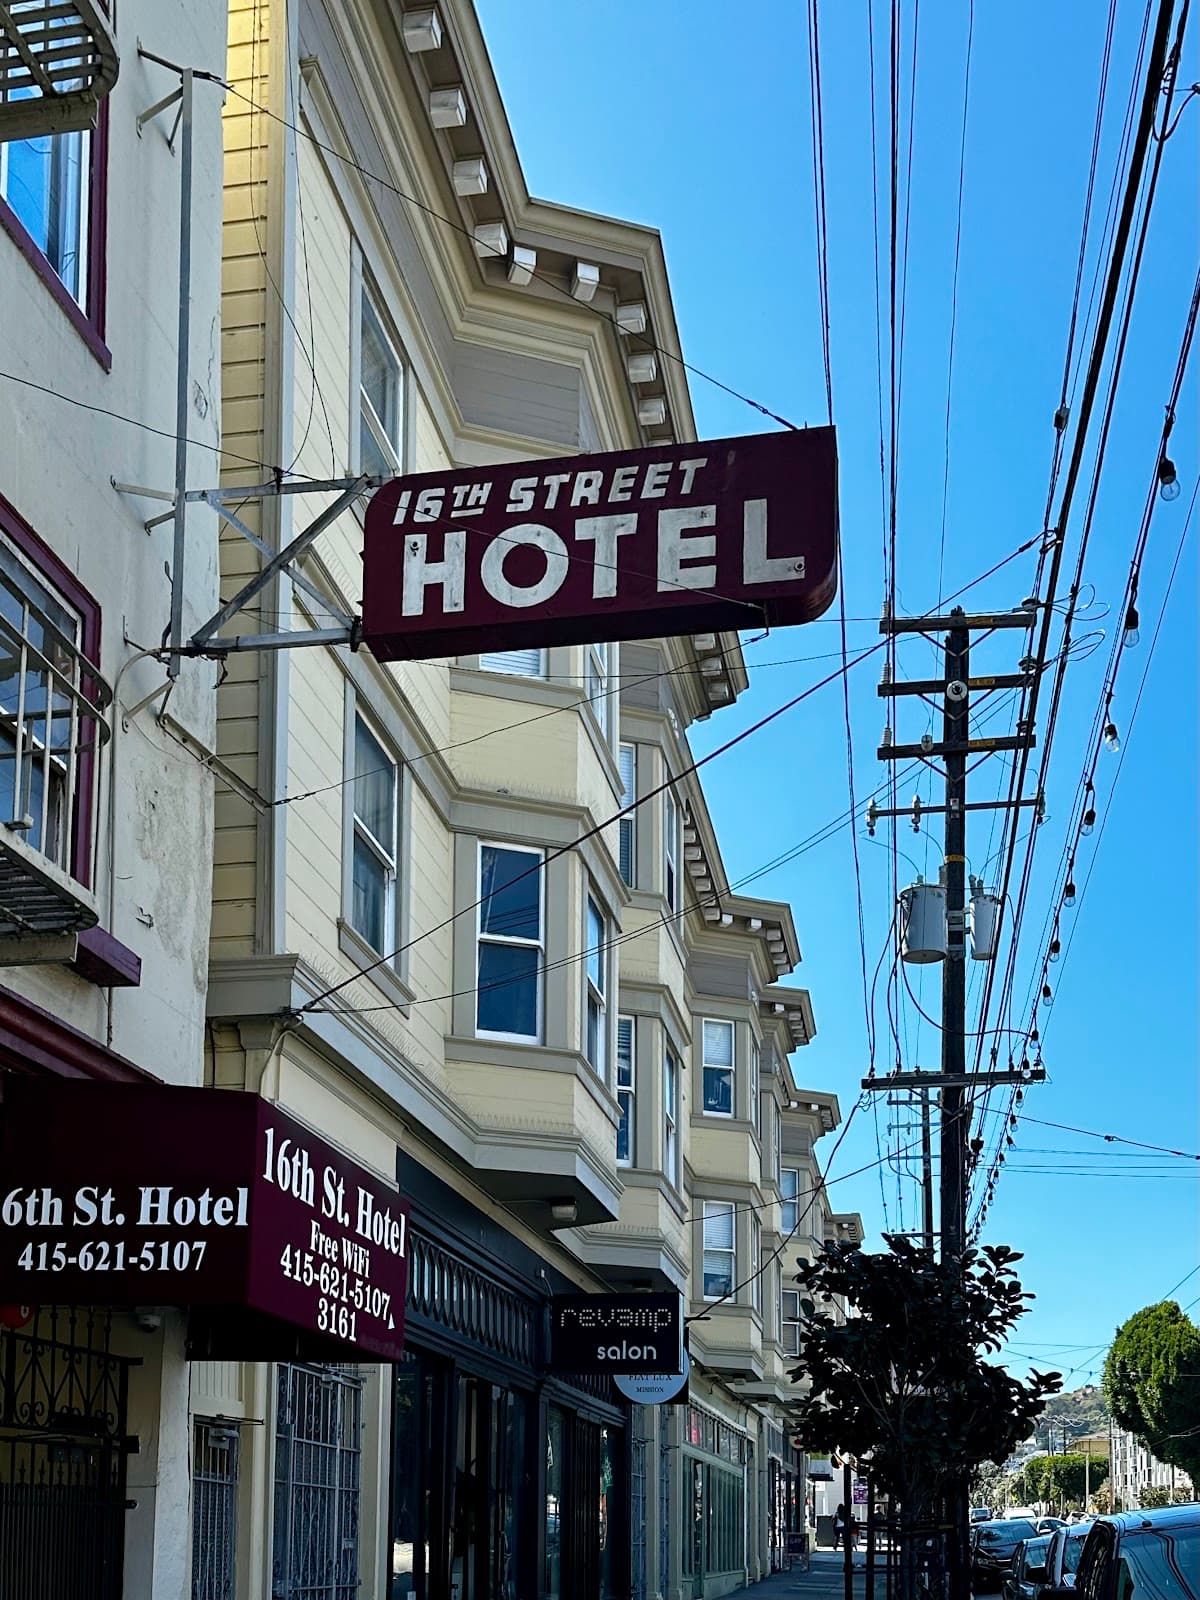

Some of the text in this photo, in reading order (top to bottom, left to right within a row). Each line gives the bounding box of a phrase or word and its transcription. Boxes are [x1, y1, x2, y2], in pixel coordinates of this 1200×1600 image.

[393, 457, 708, 526] 16TH STREET
[402, 498, 806, 617] HOTEL
[73, 1186, 126, 1226] St.
[136, 1186, 249, 1226] Hotel
[263, 1128, 406, 1258] 16th St. Hotel
[17, 1240, 207, 1271] 415-621-5107
[310, 1219, 370, 1279] Free WiFi
[280, 1243, 390, 1321] 415-621-5107
[317, 1298, 357, 1342] 3161
[560, 1308, 672, 1333] revamp
[597, 1340, 657, 1360] salon
